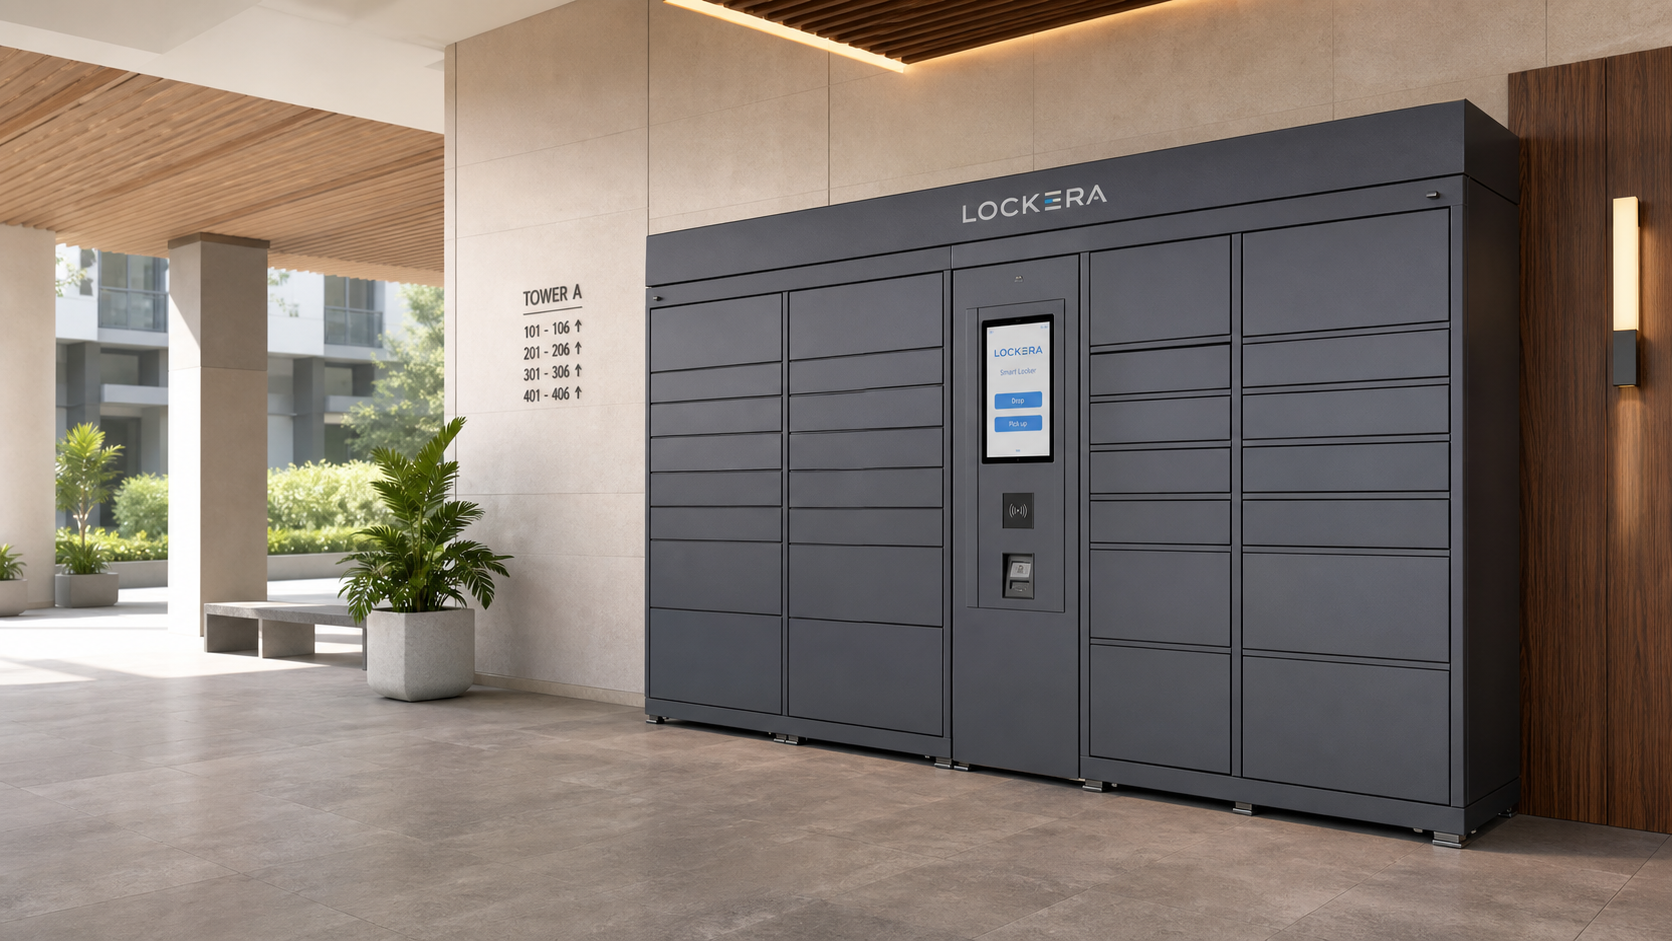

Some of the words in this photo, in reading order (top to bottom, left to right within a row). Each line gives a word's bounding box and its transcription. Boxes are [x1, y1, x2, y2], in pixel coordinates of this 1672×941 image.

[962, 184, 1108, 224] LOCKERA
[523, 285, 568, 306] TOWER
[572, 283, 582, 300] A
[524, 324, 540, 338] 101
[552, 320, 570, 335] 106
[523, 345, 540, 360] 201
[552, 342, 570, 357] 206
[994, 345, 1043, 358] LOCKERA
[523, 367, 540, 381] 301
[552, 364, 570, 379] 306
[1000, 368, 1017, 376] Smart
[523, 389, 540, 402] 401
[551, 386, 570, 401] 406
[1011, 397, 1025, 406] Drop
[1020, 420, 1028, 428] up
